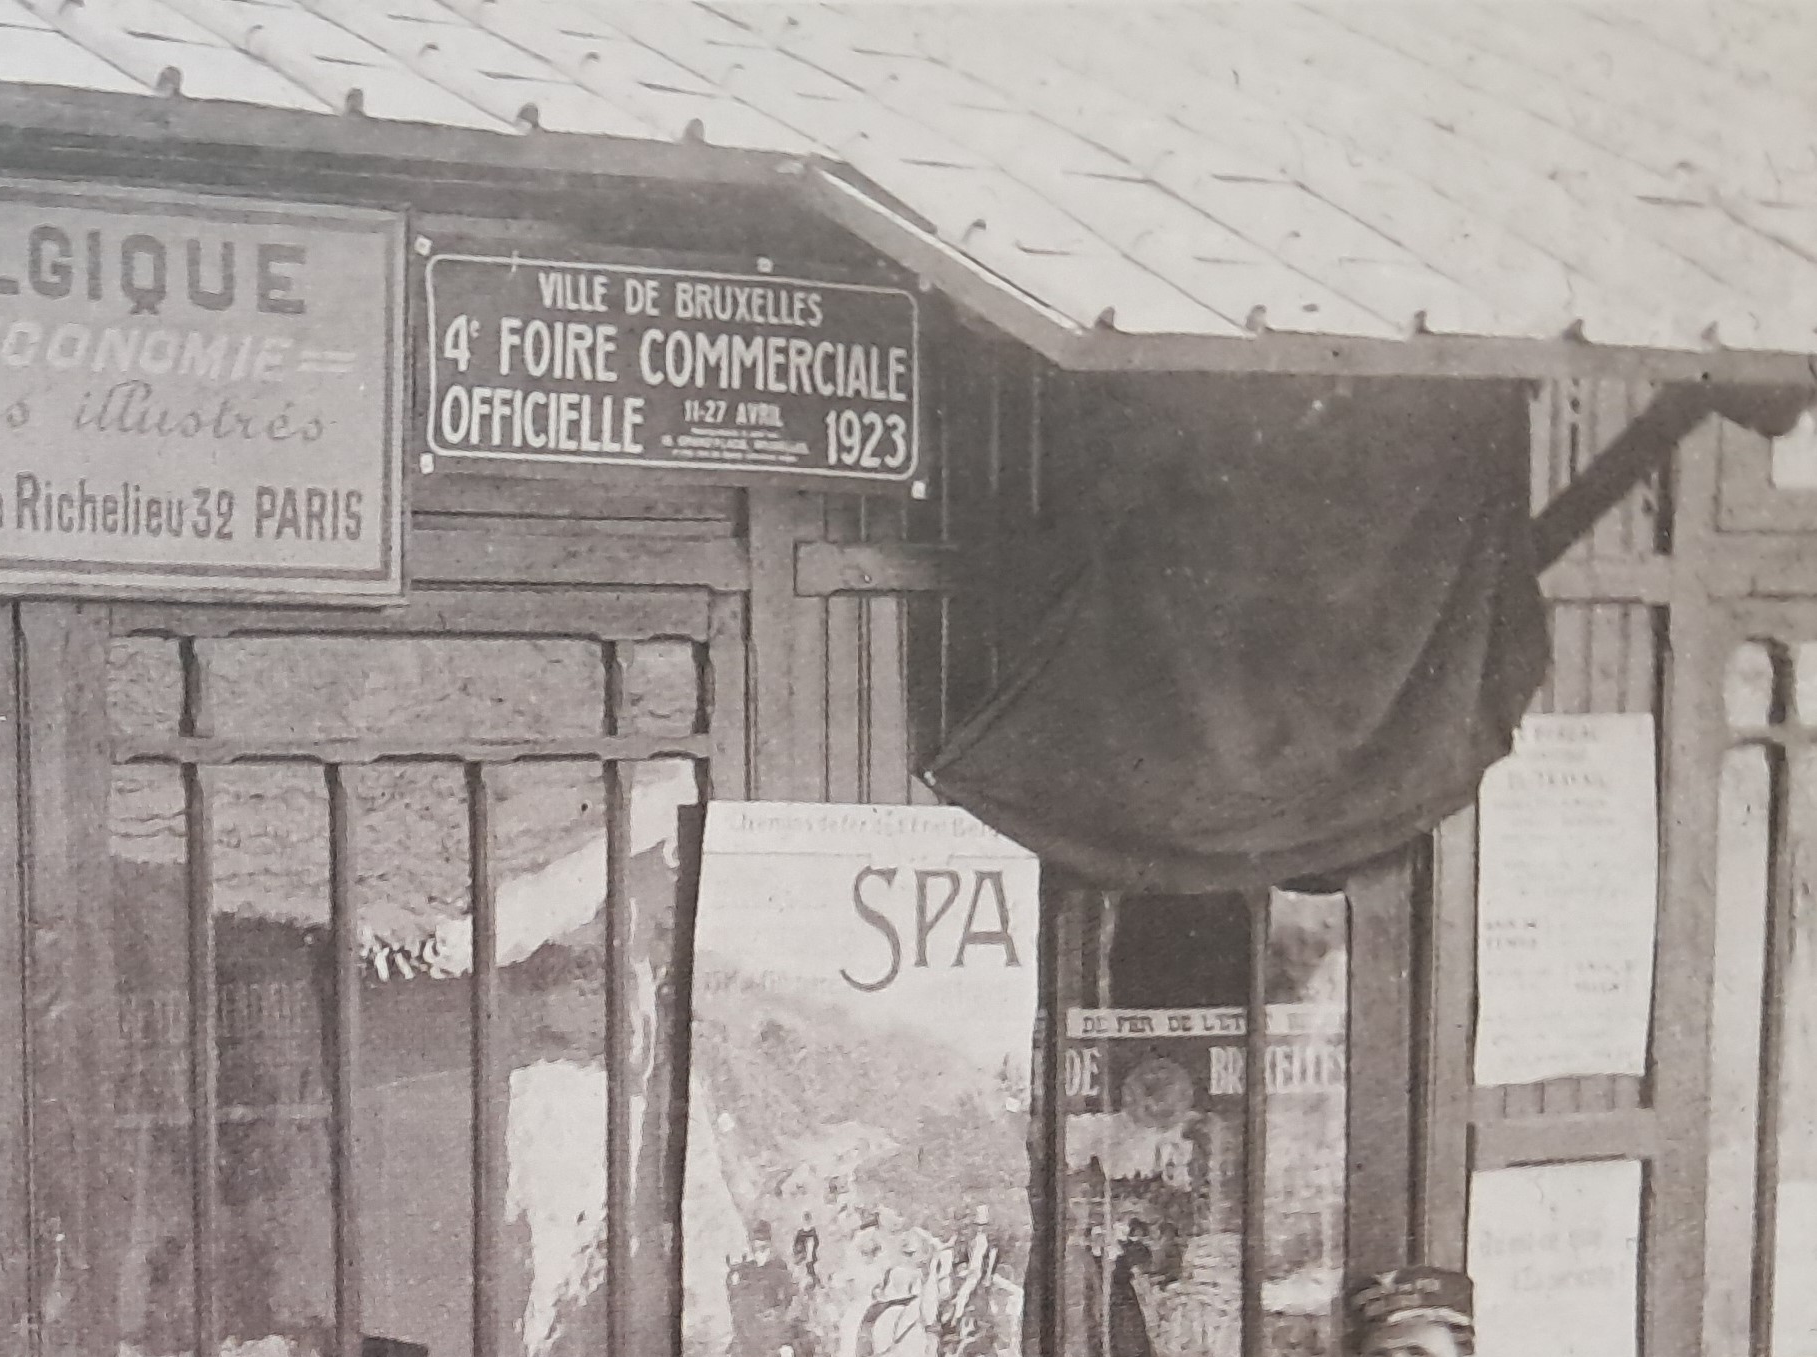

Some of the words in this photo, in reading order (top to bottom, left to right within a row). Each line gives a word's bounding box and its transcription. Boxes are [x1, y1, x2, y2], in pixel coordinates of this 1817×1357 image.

[538, 271, 609, 314] VILLE
[624, 278, 660, 318] DE
[676, 281, 824, 329] BRUXELLES
[499, 317, 618, 384] FOIRE
[639, 327, 908, 402] COMMERCIALE
[73, 380, 327, 446] illustrés
[441, 385, 645, 455] OFFICIELLE
[684, 399, 727, 424] 11-27
[825, 408, 908, 471] 1923
[15, 472, 185, 542] Richelieu
[190, 487, 237, 541] 32
[254, 486, 364, 545] PARIS
[839, 864, 1022, 993] SPA
[1064, 1046, 1101, 1097] DE
[1208, 1045, 1347, 1096] BRXELLES
